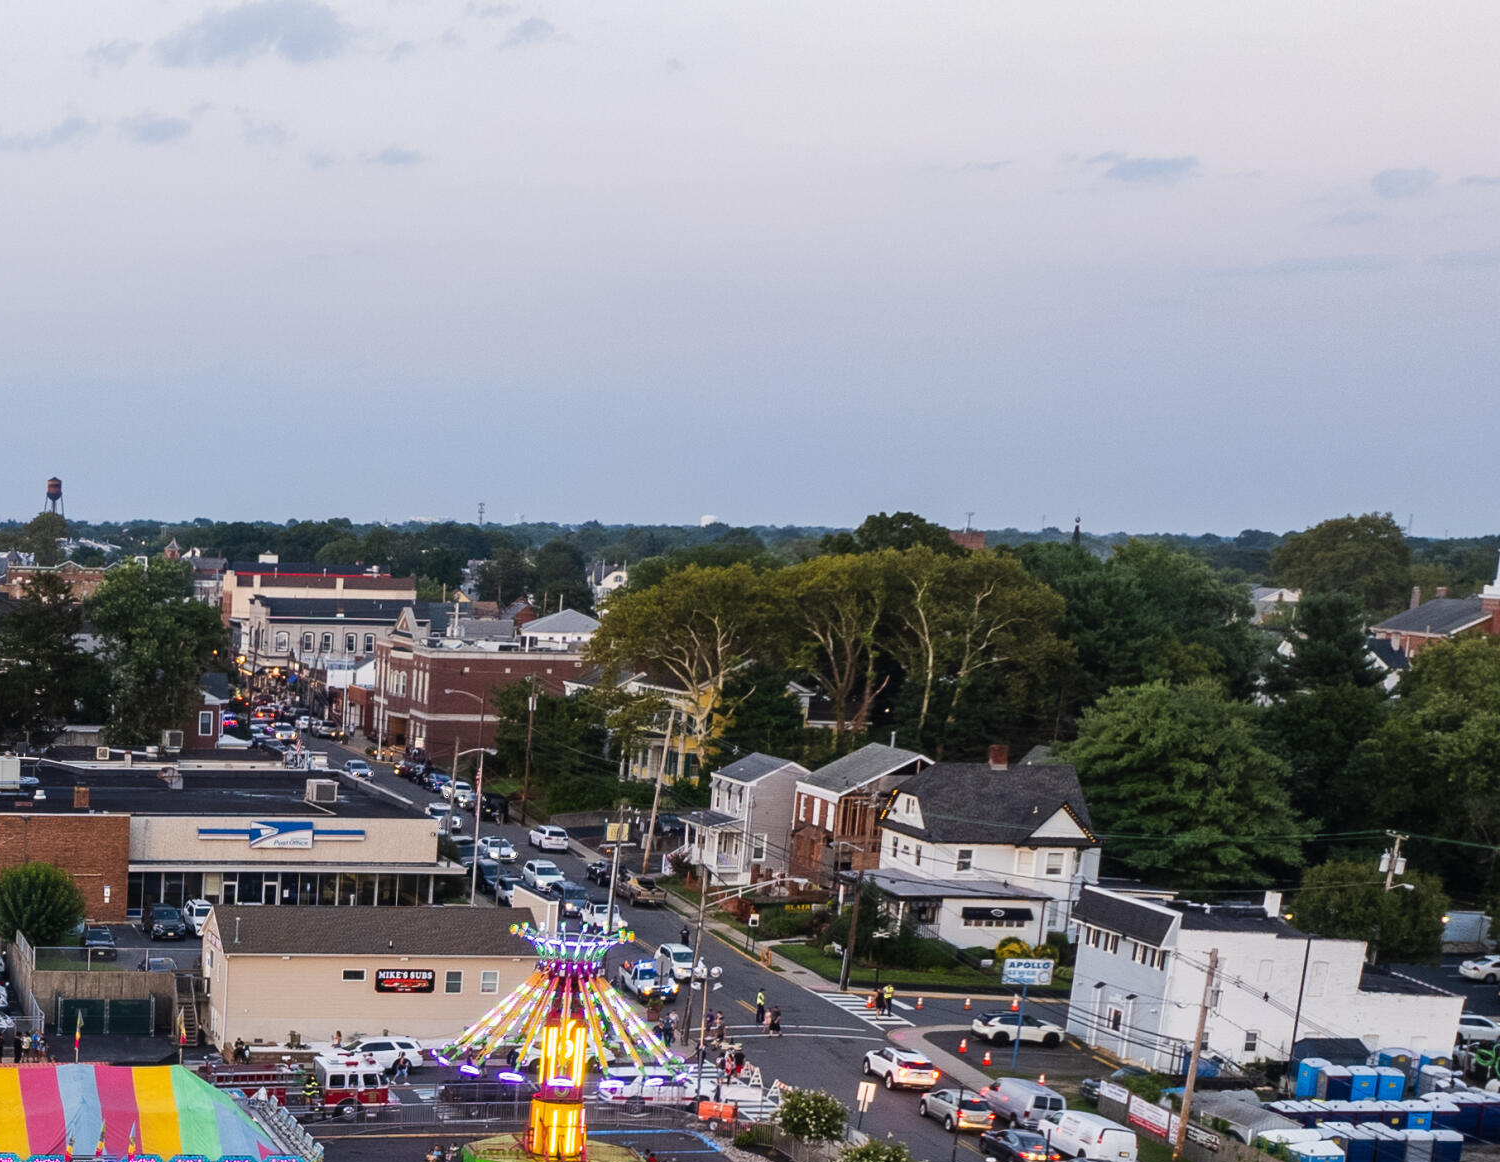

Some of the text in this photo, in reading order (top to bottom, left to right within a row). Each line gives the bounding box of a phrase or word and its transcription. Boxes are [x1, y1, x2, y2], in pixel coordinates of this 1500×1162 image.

[1009, 961, 1051, 969] APOLLO
[378, 970, 433, 980] MIKE'S SUBS
